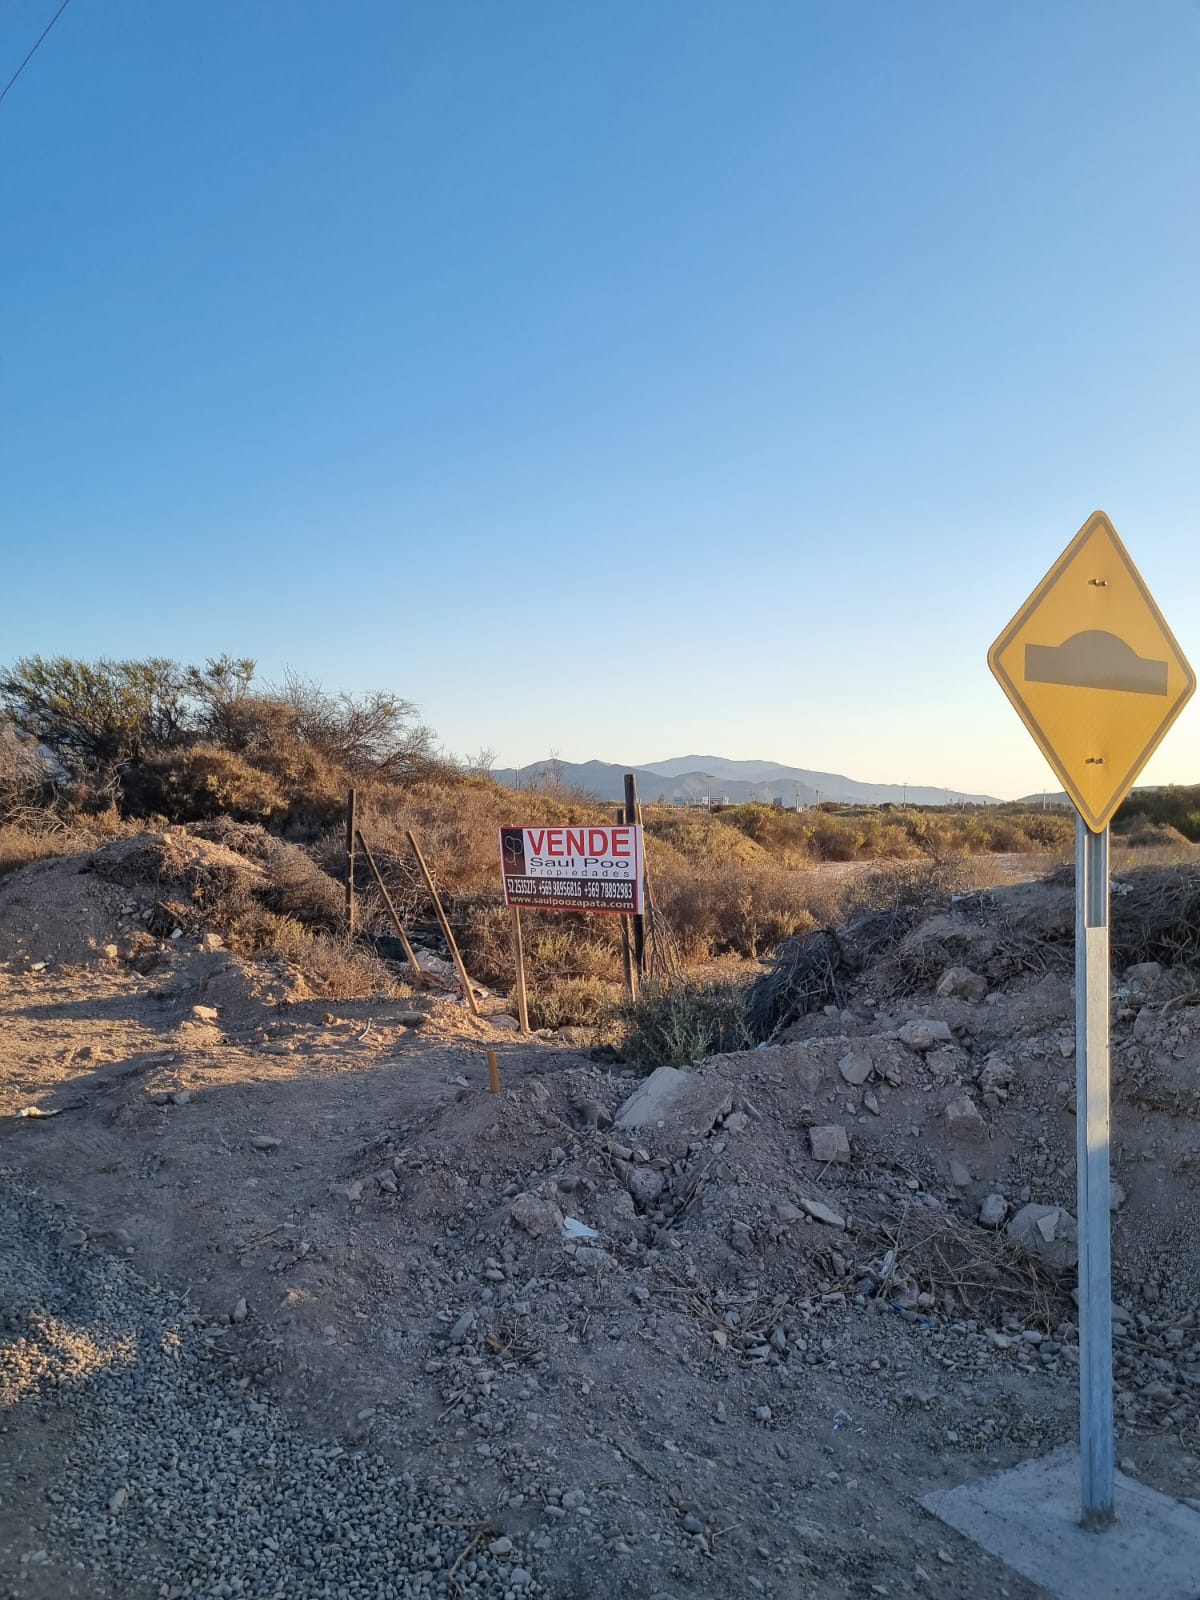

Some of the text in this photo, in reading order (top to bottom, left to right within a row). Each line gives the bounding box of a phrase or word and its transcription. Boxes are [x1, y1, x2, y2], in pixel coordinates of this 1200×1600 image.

[527, 829, 631, 857] VENDE
[530, 857, 630, 869] Saul Poo
[530, 867, 630, 878] Propiedades
[584, 881, 600, 898] +569
[600, 882, 633, 899] 78892983
[510, 896, 634, 909] www.saulpoozapata.com
